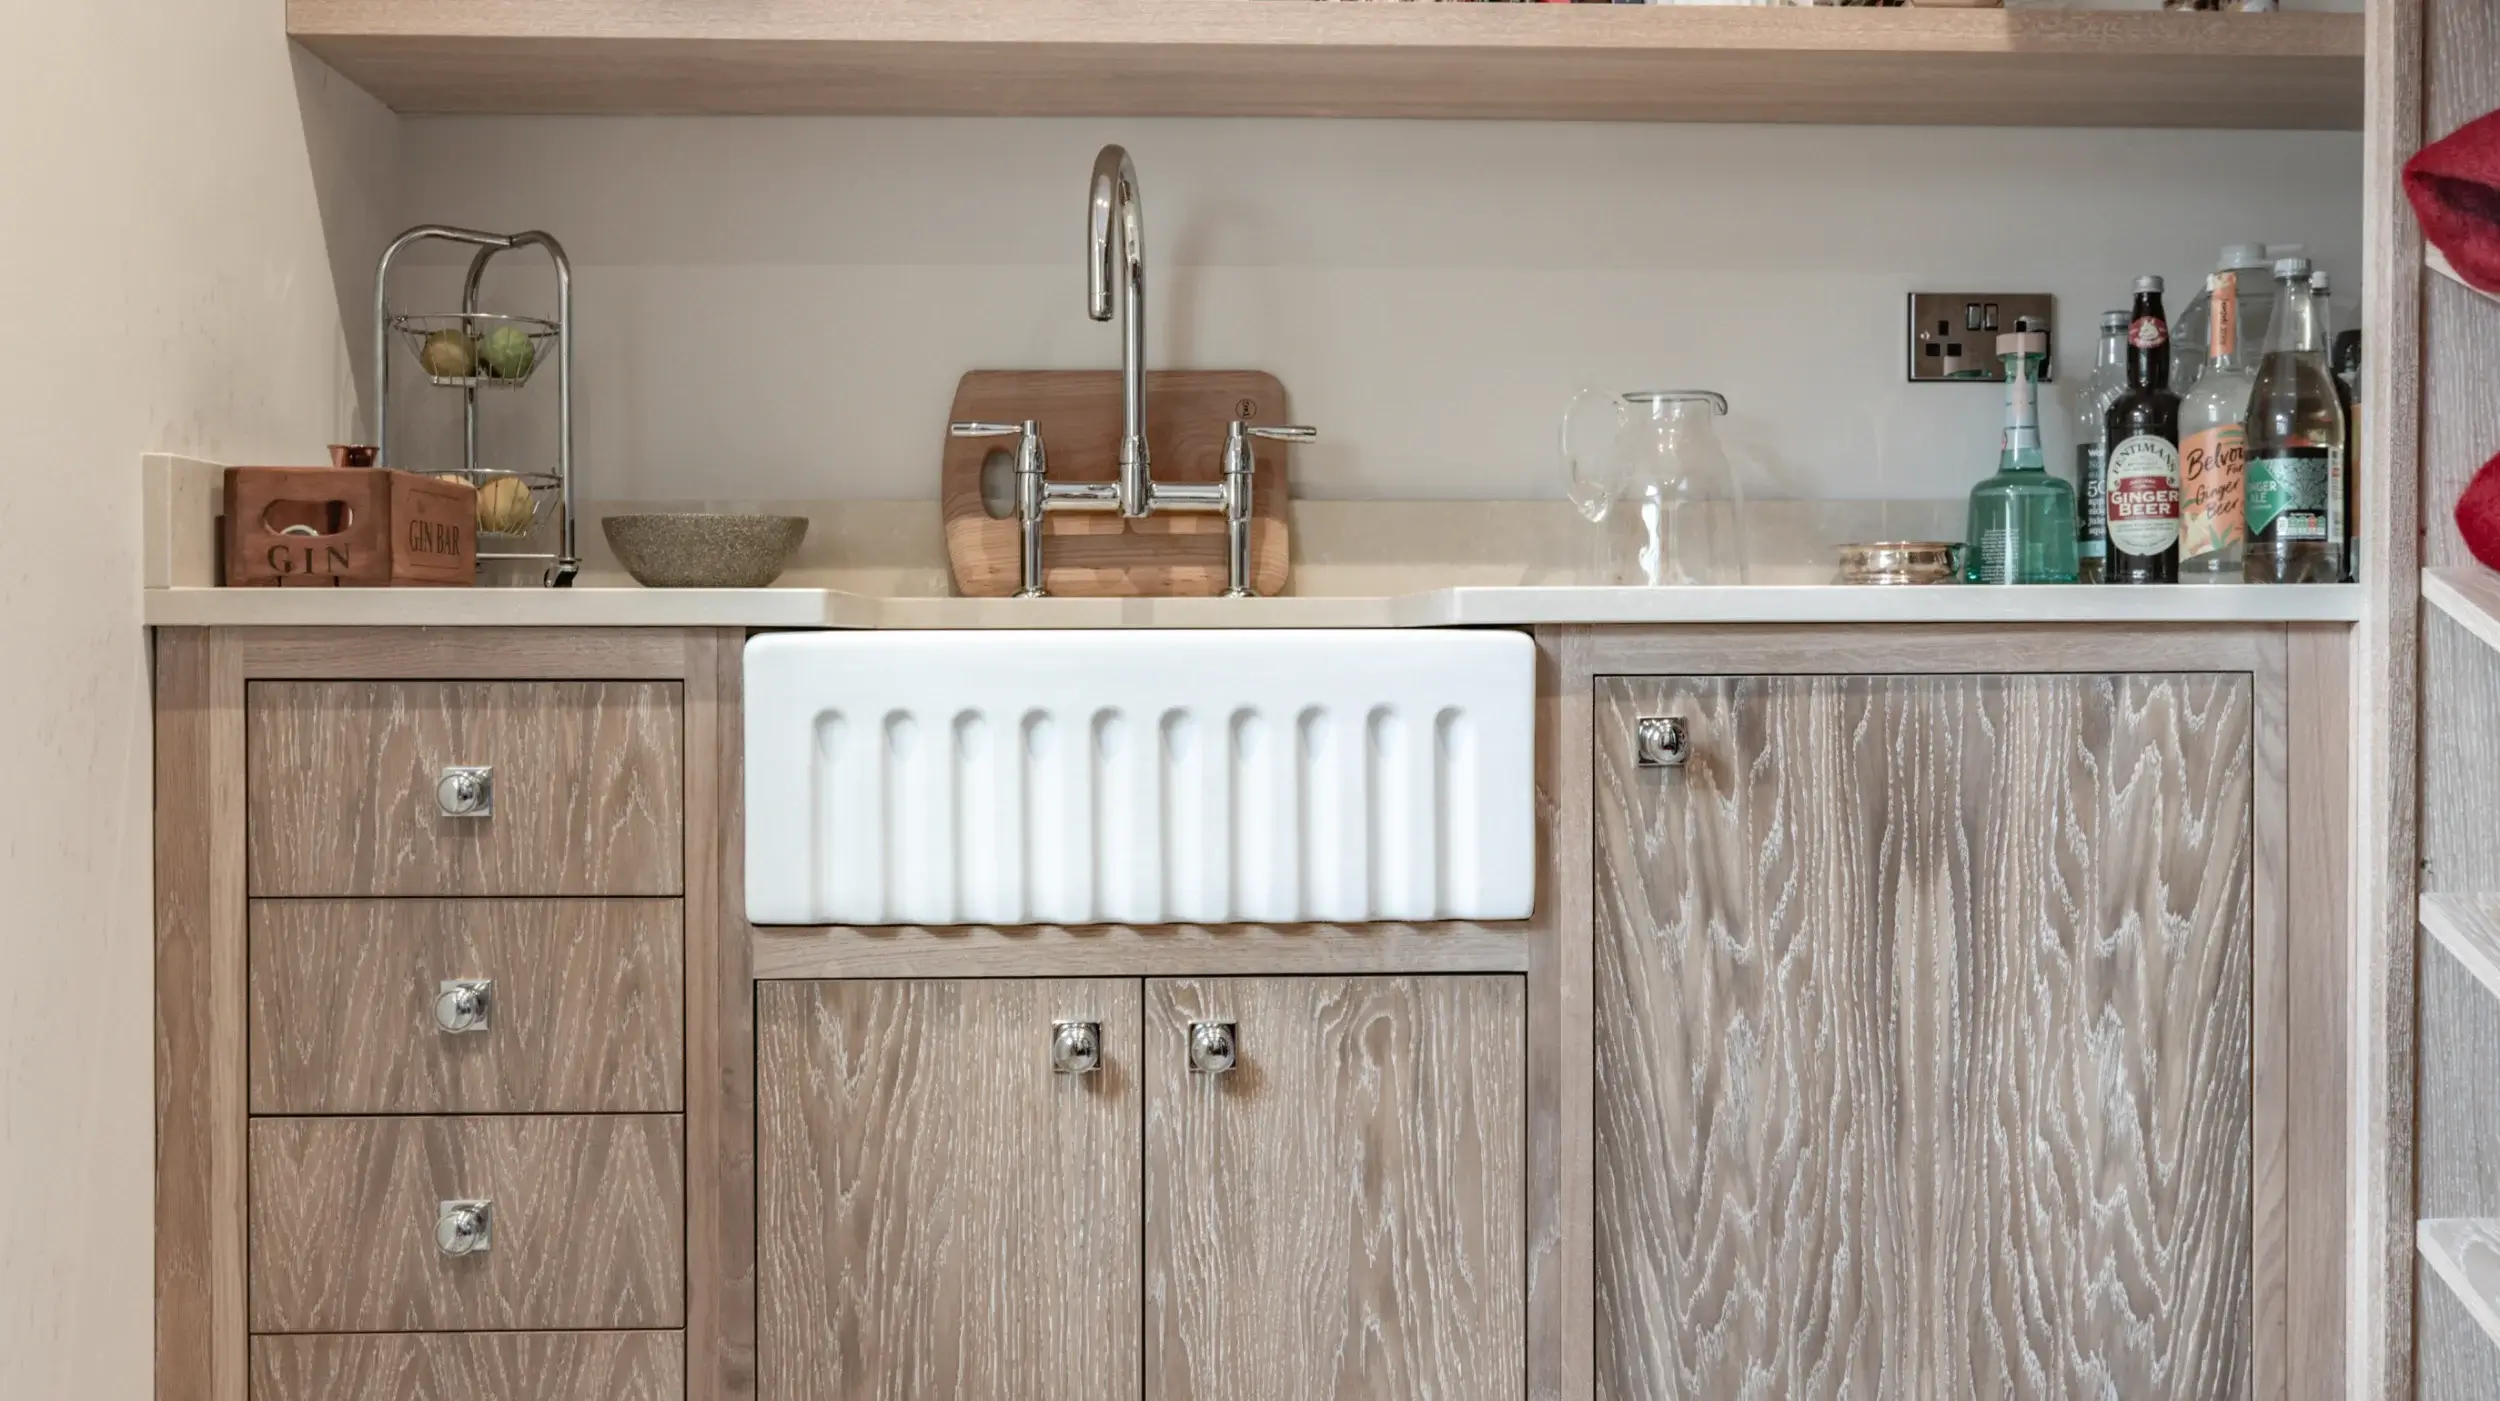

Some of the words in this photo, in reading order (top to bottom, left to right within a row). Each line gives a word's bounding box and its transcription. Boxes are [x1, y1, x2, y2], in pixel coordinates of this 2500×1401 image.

[2112, 443, 2177, 474] FENTIMANS
[2187, 442, 2244, 481] Belvoi
[2111, 490, 2179, 504] GINGER
[2195, 479, 2239, 505] Ginger
[2119, 503, 2171, 516] BEER
[2207, 498, 2239, 519] Beer
[409, 520, 433, 554] GIN
[437, 523, 460, 556] BAR
[267, 543, 350, 574] GIN
